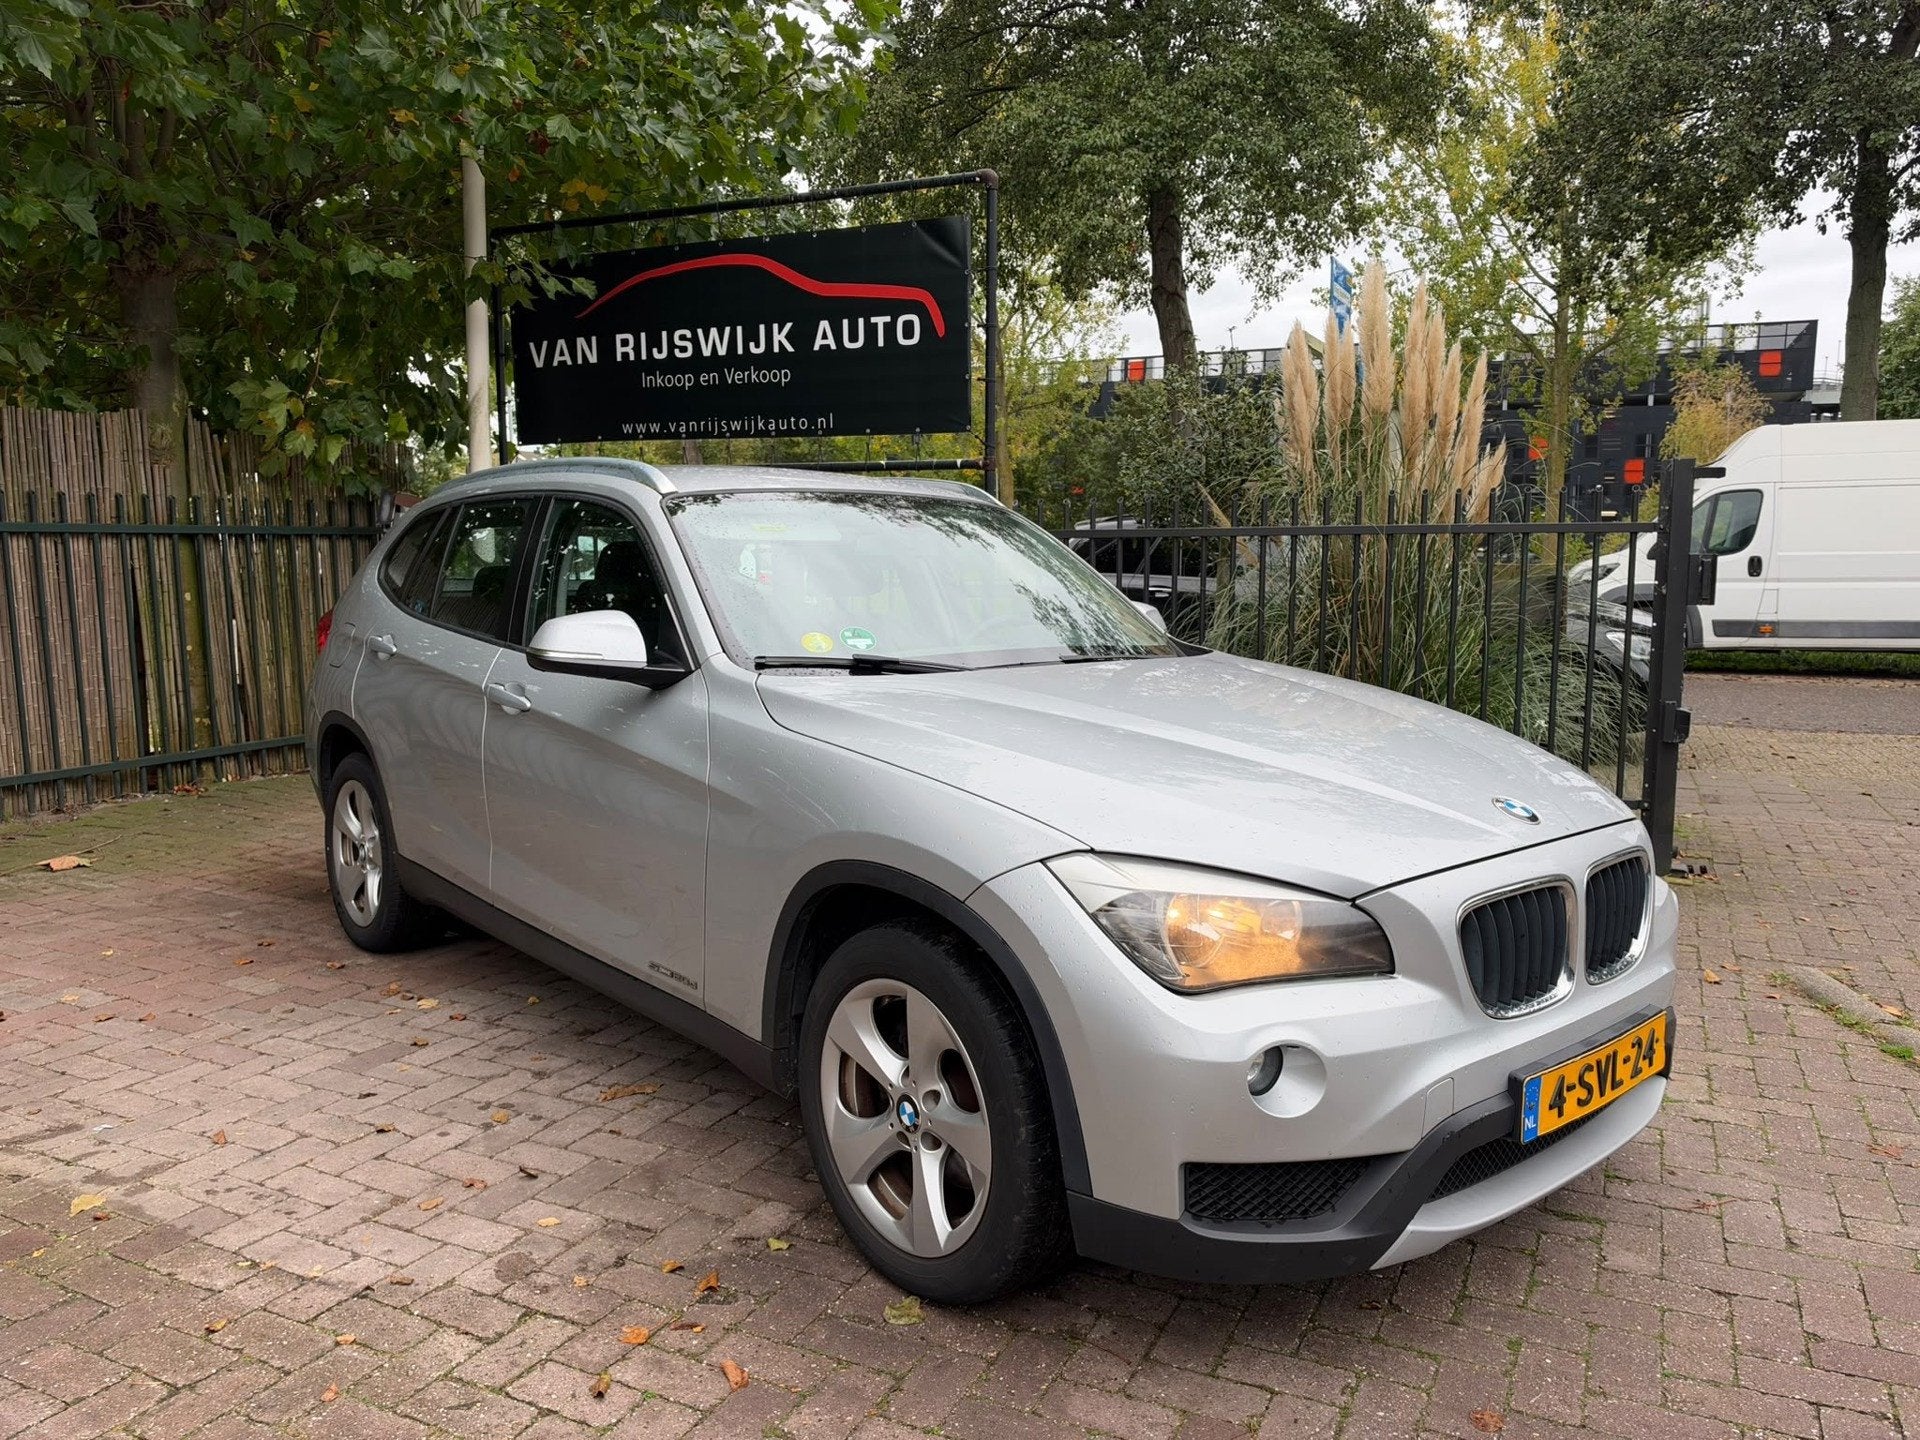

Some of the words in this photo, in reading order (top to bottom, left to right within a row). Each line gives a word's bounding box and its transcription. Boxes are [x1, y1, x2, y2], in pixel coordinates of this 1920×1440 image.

[529, 335, 598, 368] VAN
[615, 321, 795, 362] RIJSWIJK
[812, 313, 921, 351] AUTO
[642, 370, 695, 391] Inkoop
[700, 372, 719, 386] en
[725, 365, 791, 388] Verkoop
[622, 412, 834, 436] www.vanrijswijkauto.nl
[1548, 1027, 1660, 1119] 4-SVL-24
[1524, 1114, 1537, 1131] NL
